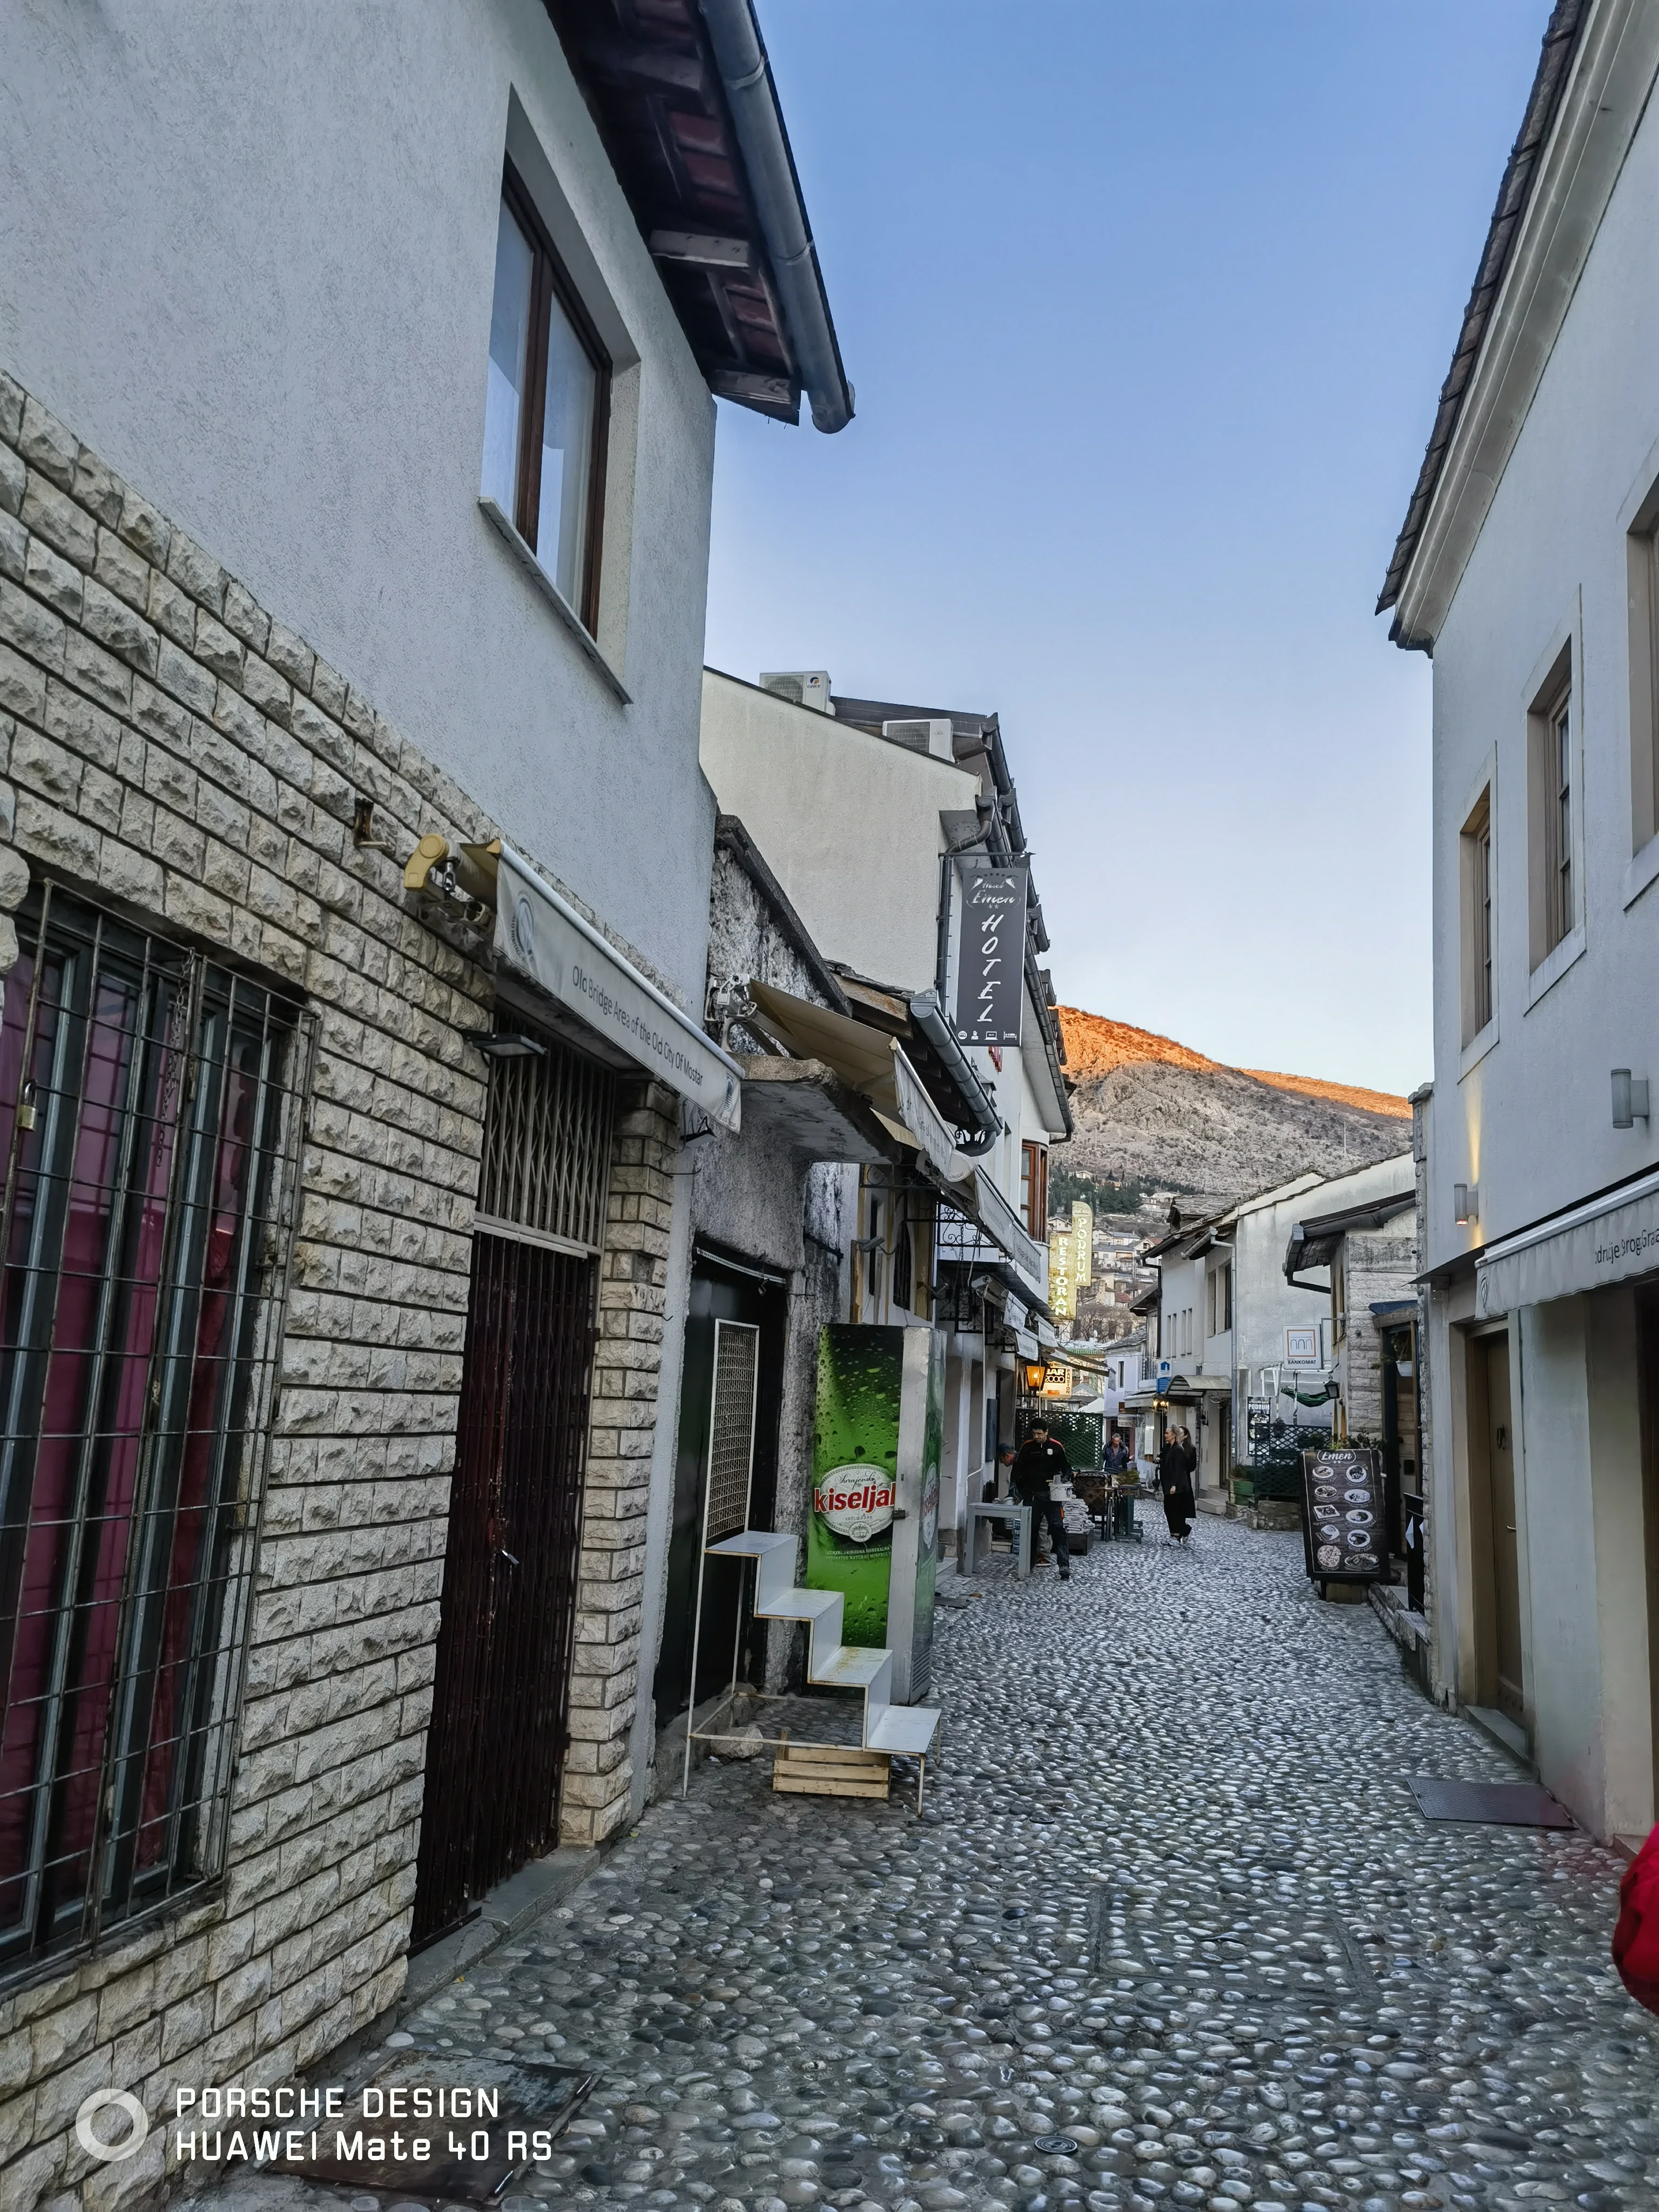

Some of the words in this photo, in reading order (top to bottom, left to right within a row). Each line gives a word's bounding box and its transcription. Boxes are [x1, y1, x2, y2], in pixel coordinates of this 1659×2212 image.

[976, 914, 1004, 1022] HOTEL
[572, 965, 587, 993] Old
[589, 979, 612, 1015] Bridge
[613, 1001, 630, 1028] Area
[631, 1017, 639, 1036] of
[640, 1022, 651, 1046] the
[652, 1032, 663, 1055] Old
[664, 1042, 676, 1069] City
[676, 1051, 684, 1071] Of
[684, 1057, 704, 1087] Mostar
[1055, 1237, 1069, 1317] RESTORAN
[1075, 1218, 1087, 1283] PODRUM
[1321, 1452, 1353, 1461] Emen
